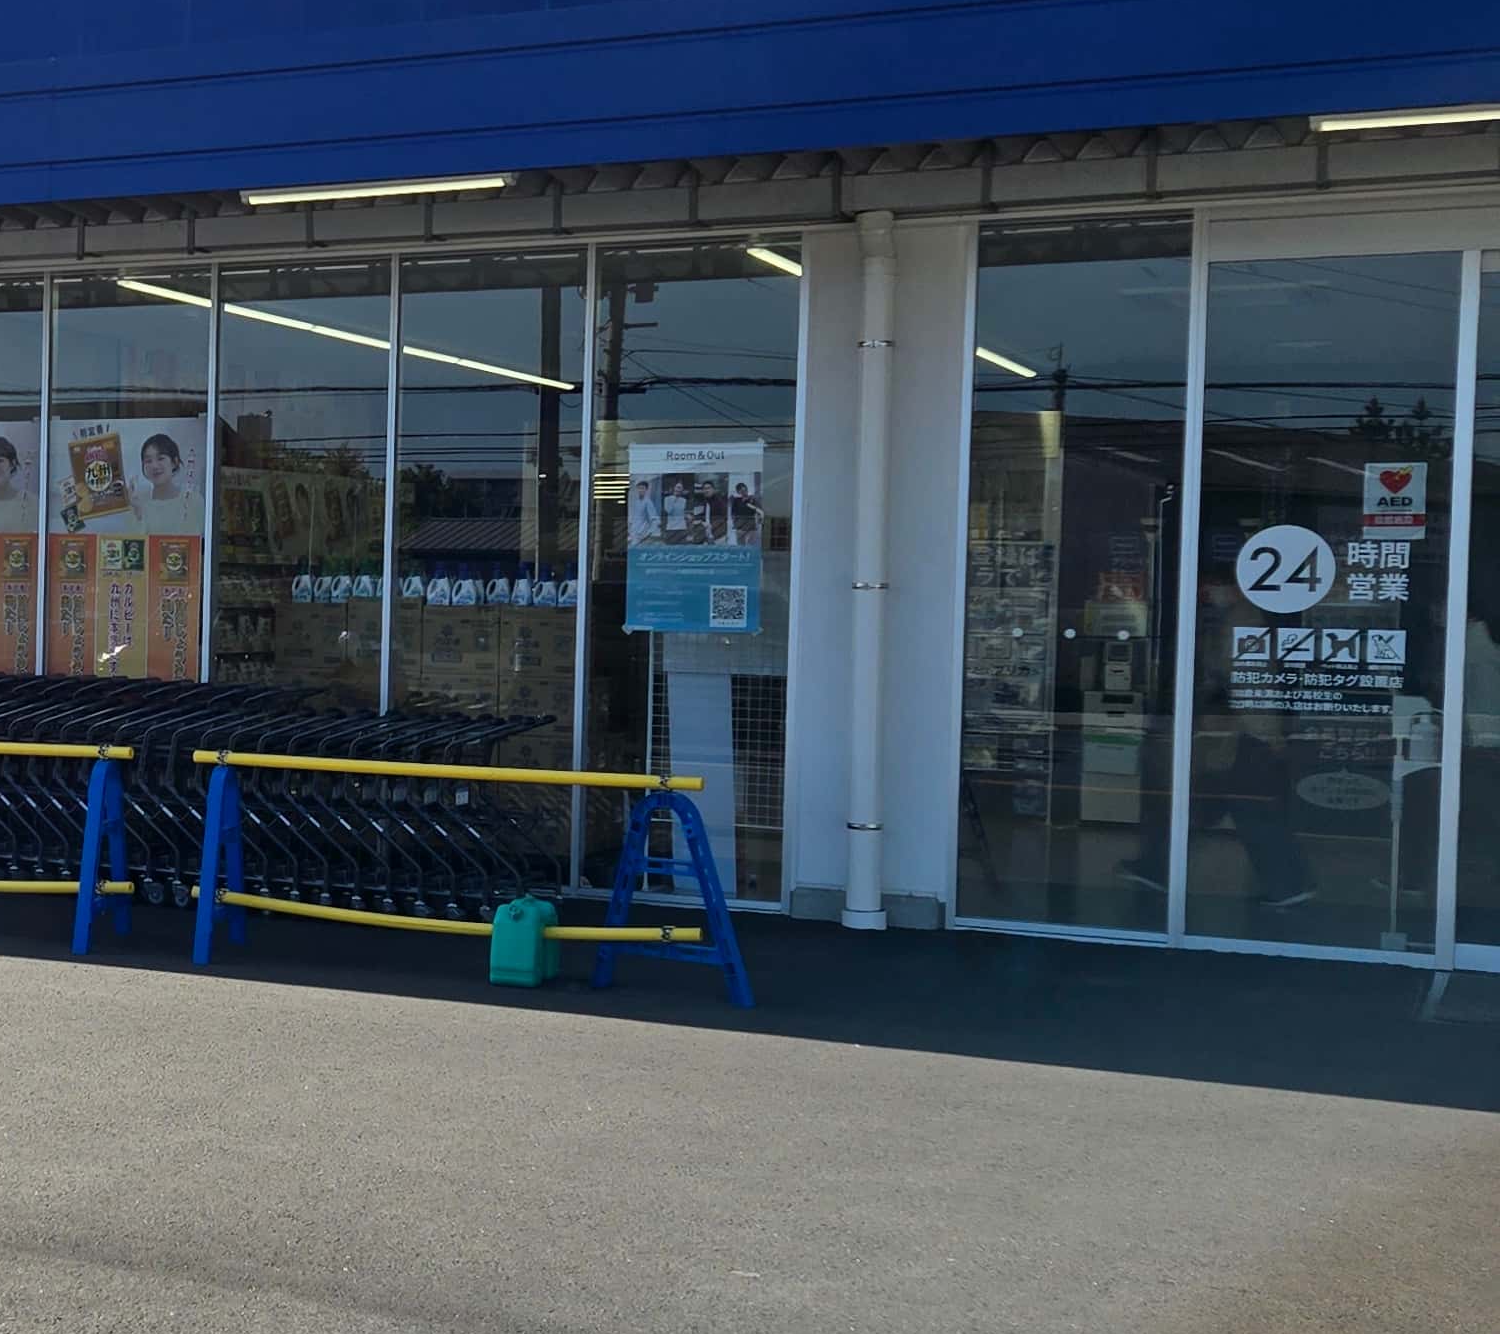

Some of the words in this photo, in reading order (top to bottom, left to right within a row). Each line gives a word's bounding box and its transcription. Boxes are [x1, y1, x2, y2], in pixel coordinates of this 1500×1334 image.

[1377, 496, 1413, 507] AED
[1249, 546, 1321, 593] 24
[1347, 541, 1411, 570] 時間
[1346, 573, 1410, 602] 営業
